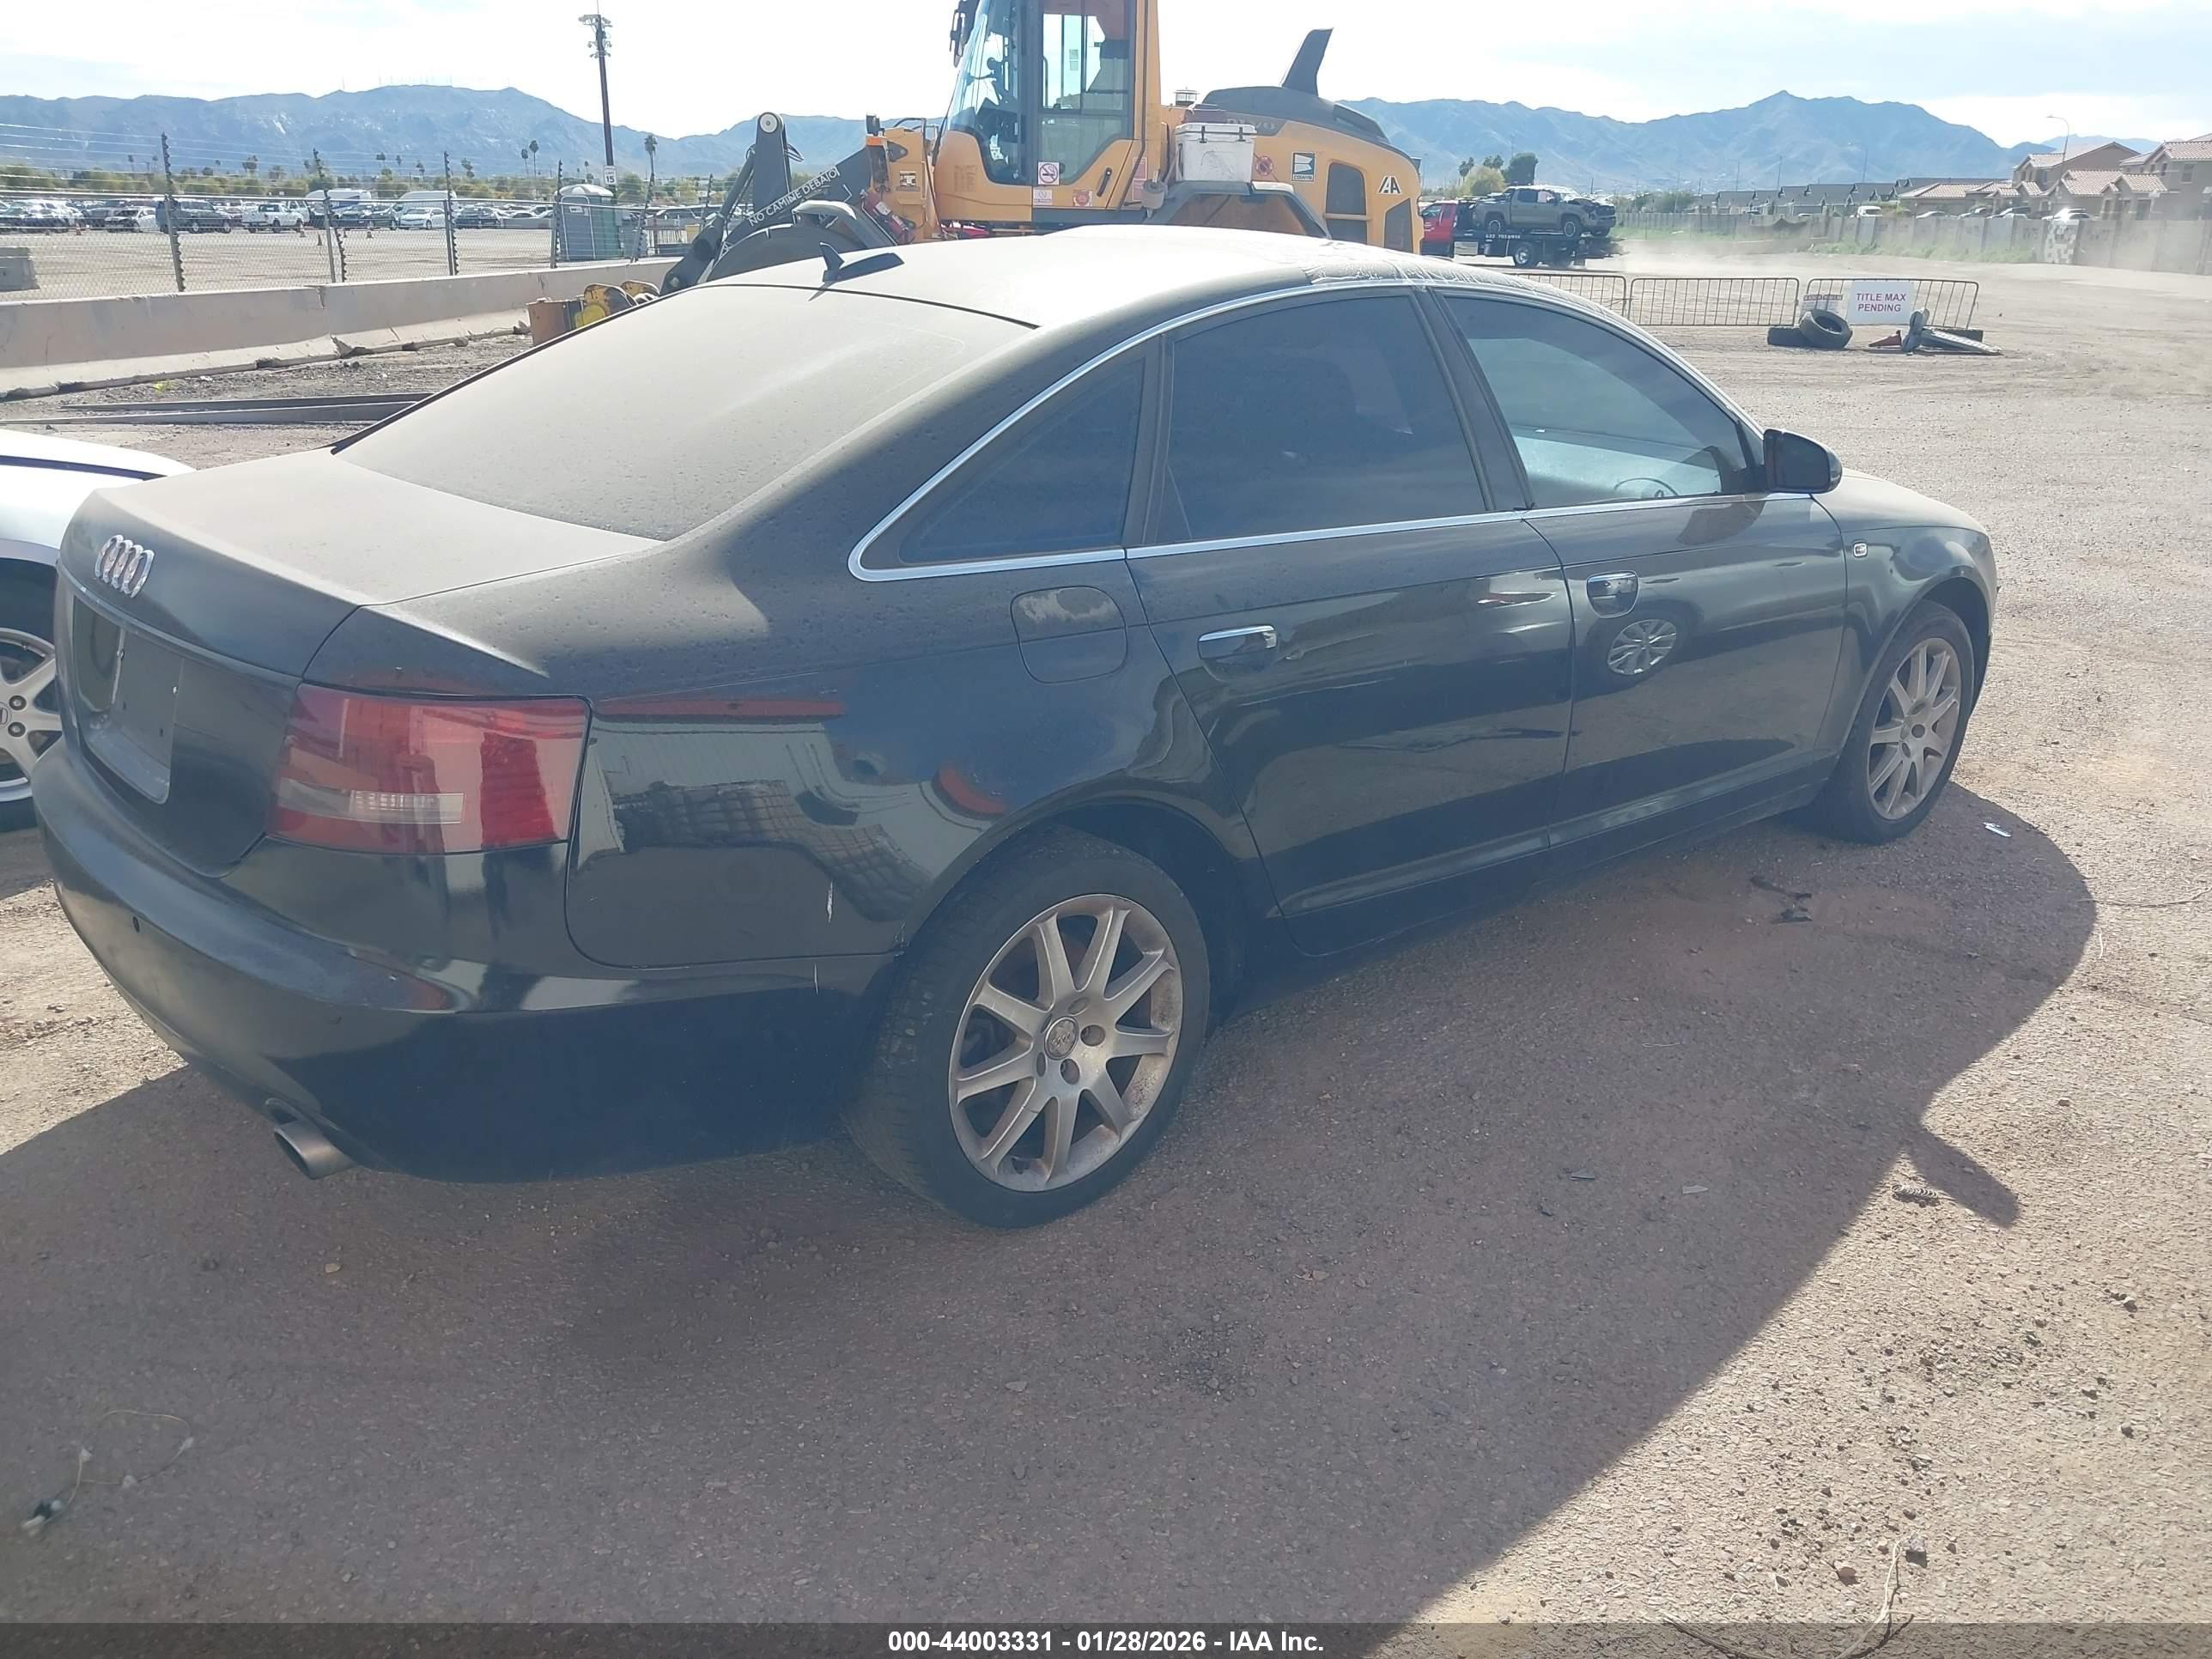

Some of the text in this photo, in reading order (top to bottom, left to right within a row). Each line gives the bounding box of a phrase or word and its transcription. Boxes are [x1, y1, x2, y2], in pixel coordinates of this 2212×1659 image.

[748, 170, 837, 227] NO CAMINE DEBAJO
[1856, 293, 1906, 301] TITLE MAX
[1857, 303, 1901, 312] PENDING
